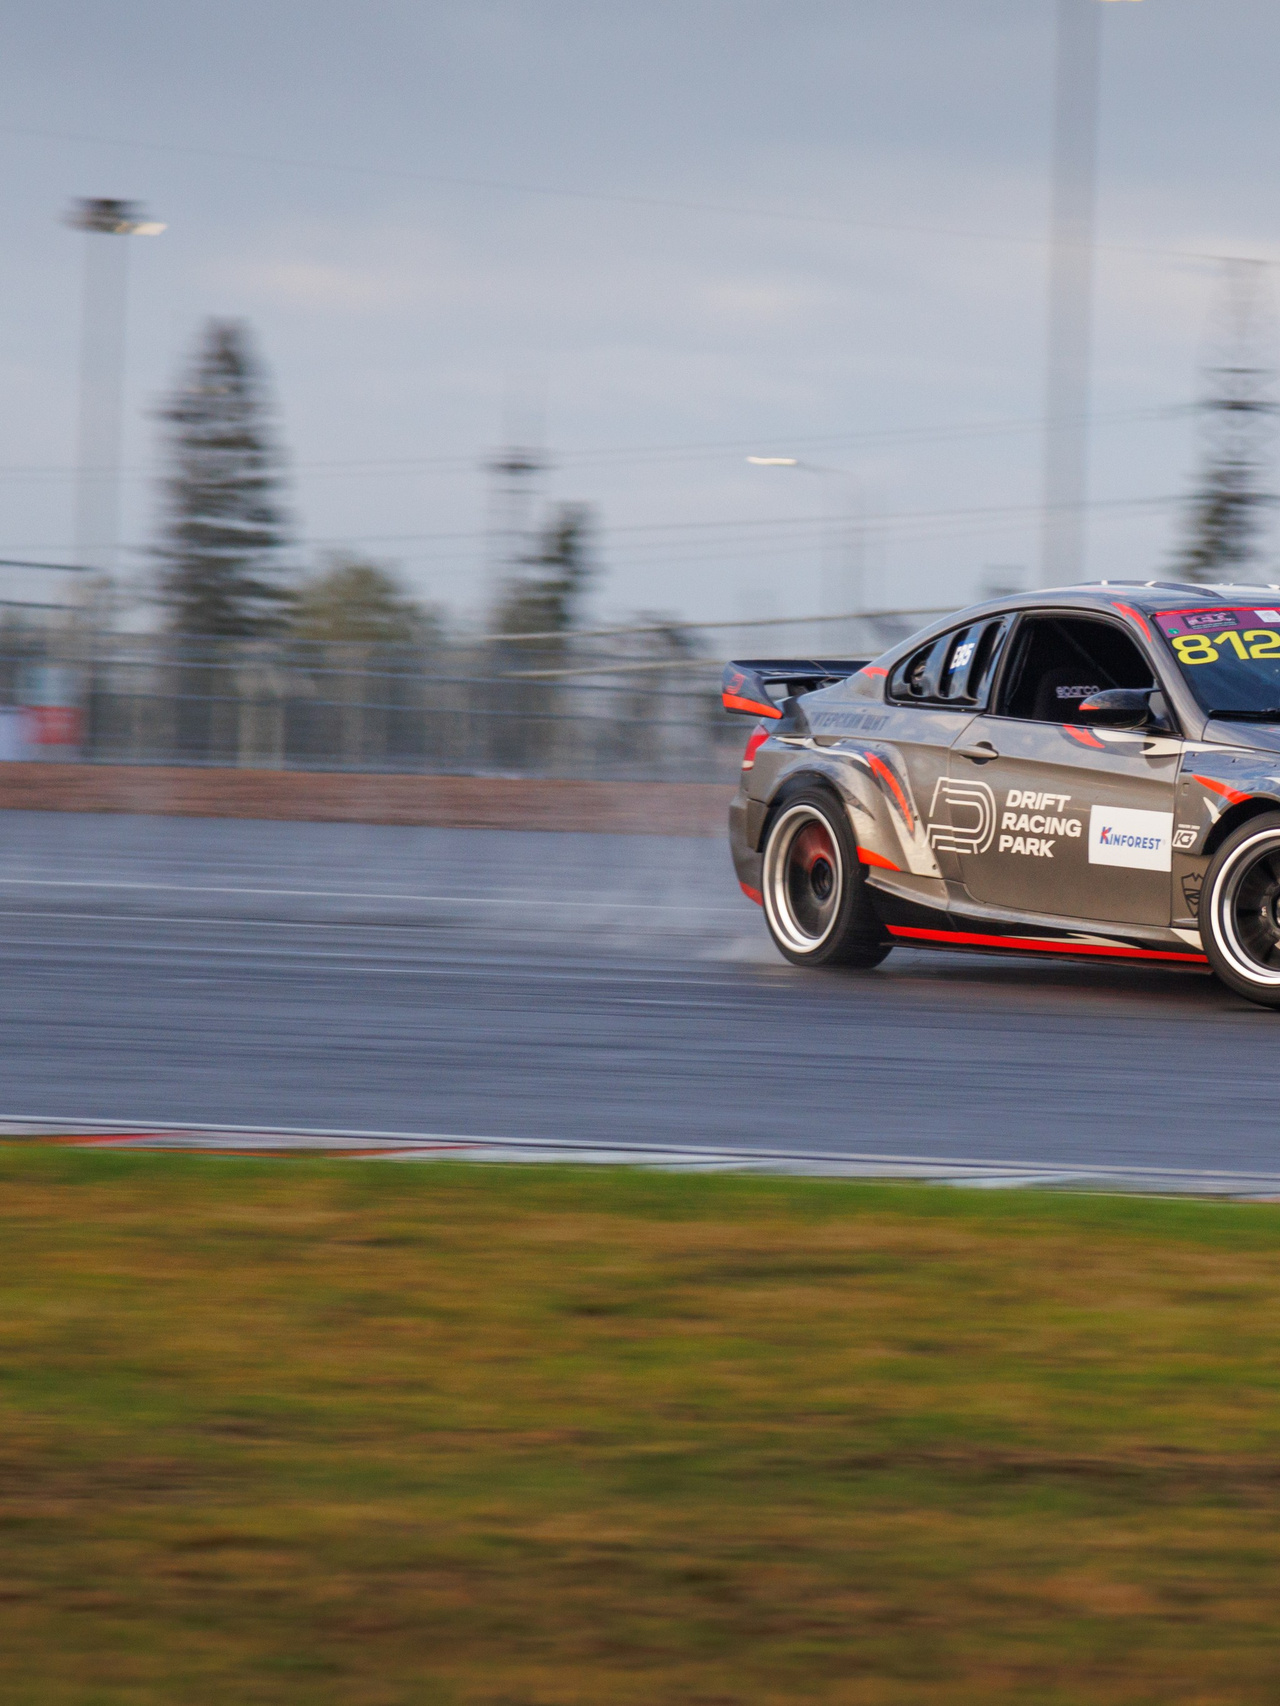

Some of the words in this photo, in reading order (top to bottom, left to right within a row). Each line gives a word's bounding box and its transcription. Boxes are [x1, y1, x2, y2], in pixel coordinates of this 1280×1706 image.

[1005, 789, 1072, 812] DRIFT
[1001, 812, 1083, 838] RACING
[998, 834, 1056, 858] PARK
[1099, 826, 1161, 850] KINFOREST
